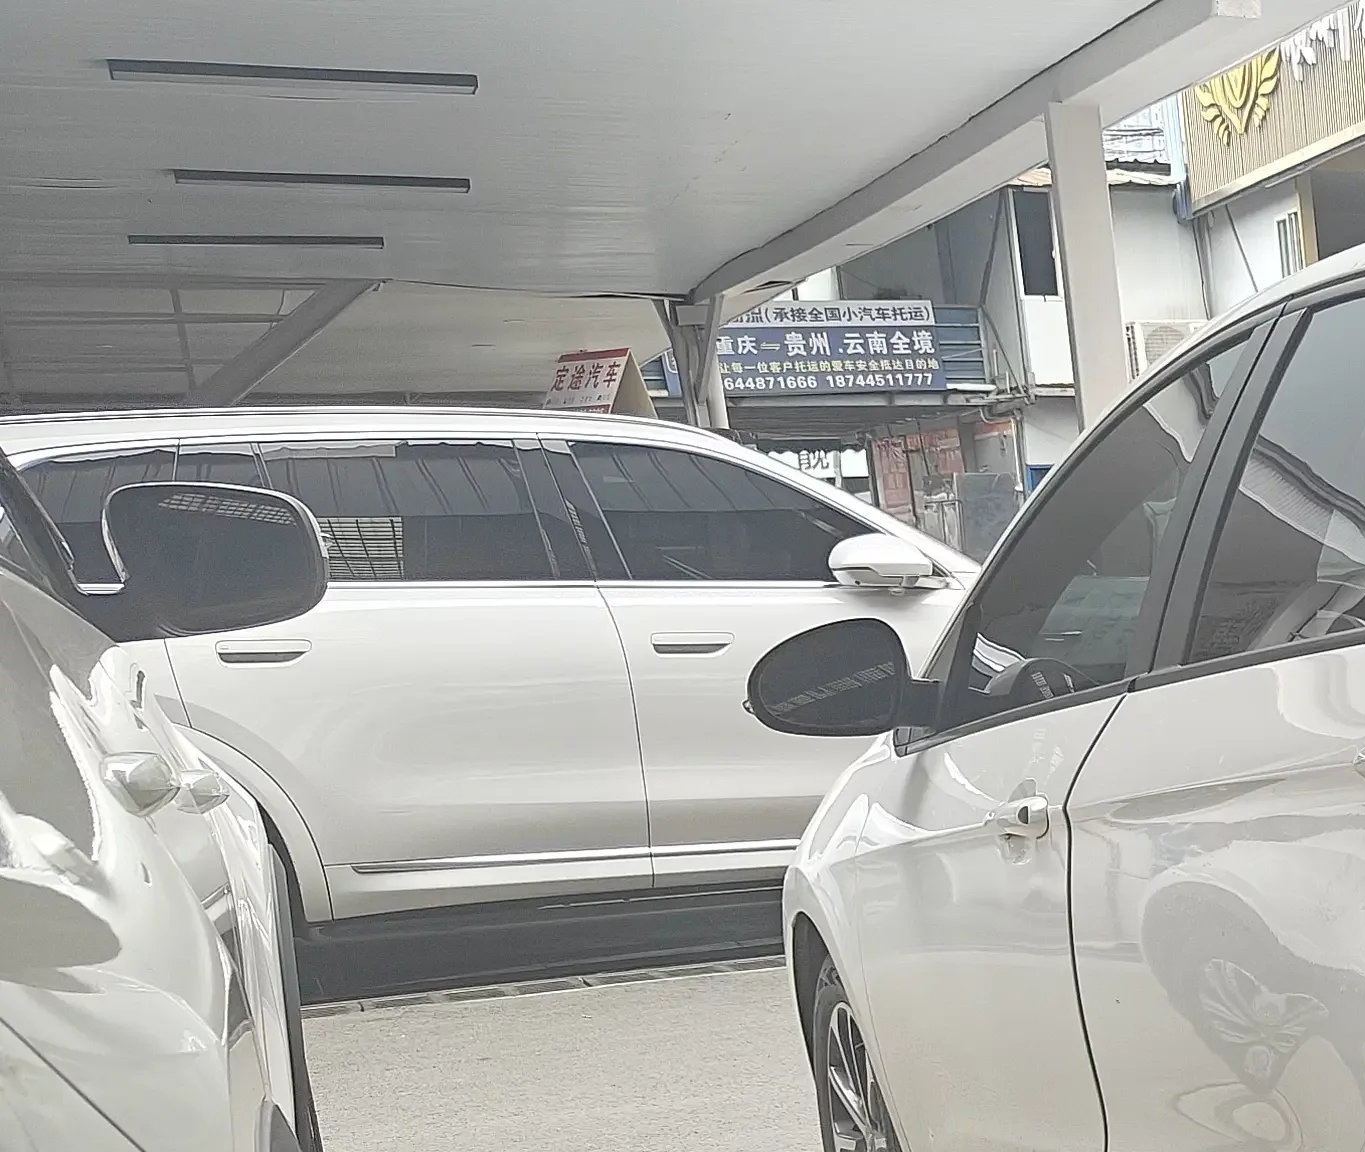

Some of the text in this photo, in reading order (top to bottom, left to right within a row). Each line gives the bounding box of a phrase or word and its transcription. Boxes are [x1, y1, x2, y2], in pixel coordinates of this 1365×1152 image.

[732, 305, 931, 324] 流(承接全国小汽车托运)
[716, 334, 758, 356] 重庆
[719, 358, 940, 375] 让每一位客户托运的爱车安全抵达目的地
[723, 373, 933, 391] 644871666 18744511777
